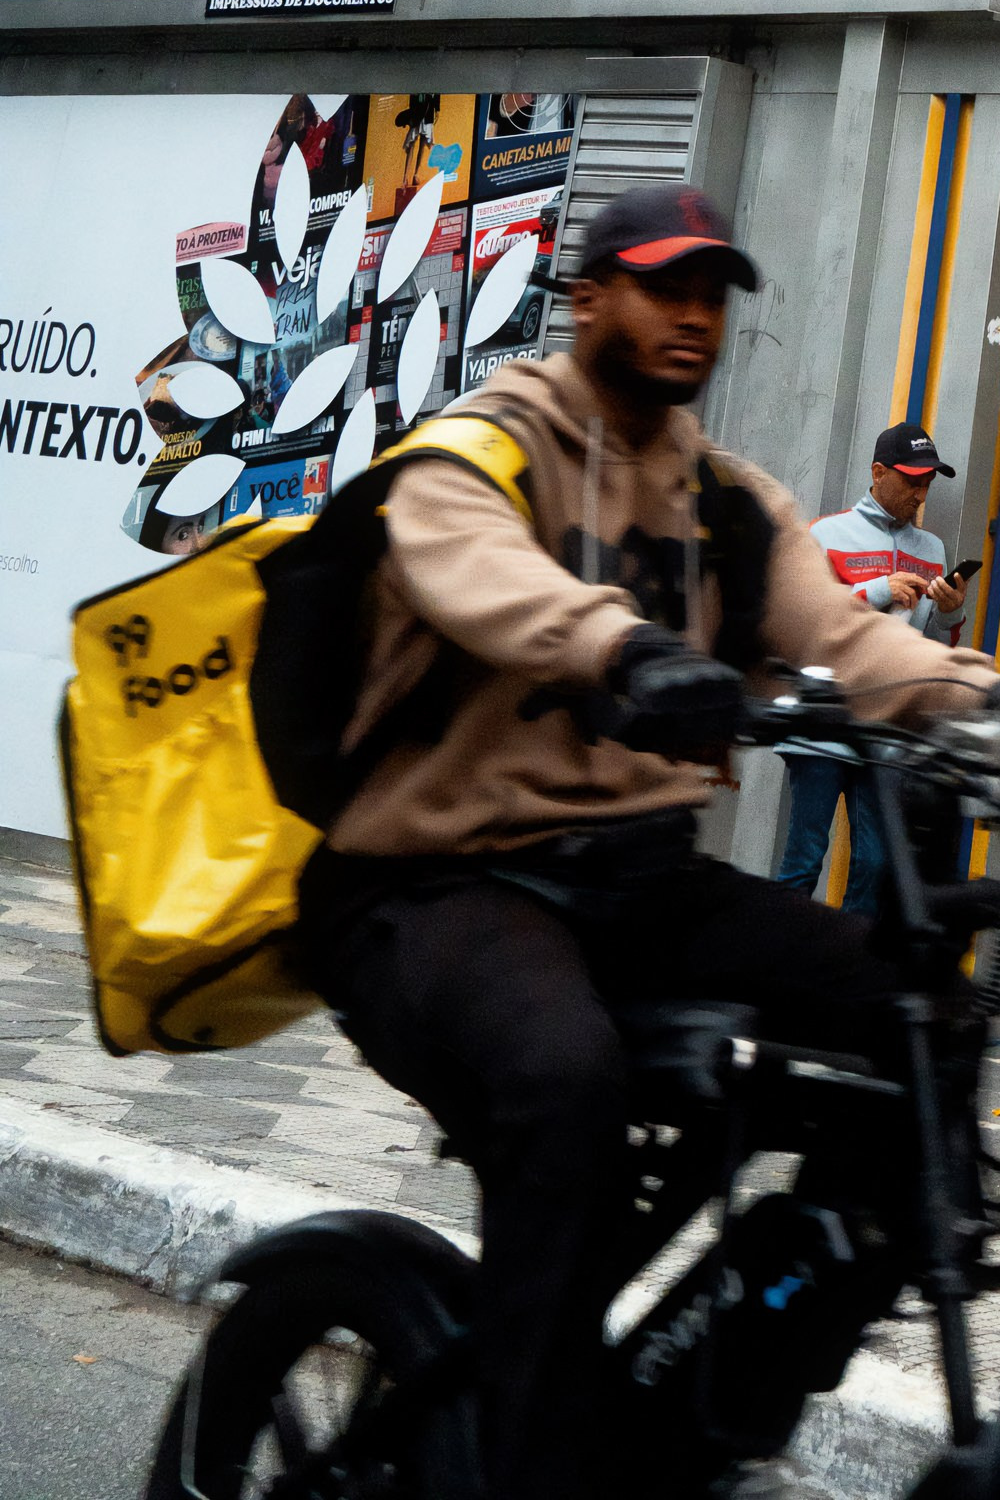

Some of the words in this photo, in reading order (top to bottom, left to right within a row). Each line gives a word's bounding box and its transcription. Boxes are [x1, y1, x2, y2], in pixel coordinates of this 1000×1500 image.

[481, 144, 535, 171] CANETAS
[535, 140, 553, 159] NA
[476, 203, 495, 217] TESTE
[494, 202, 502, 213] DO
[501, 200, 518, 212] NOVO
[518, 195, 541, 207] JETOUR
[541, 193, 548, 203] T2
[188, 234, 197, 249] À
[199, 225, 245, 248] PROTEÍNA
[0, 398, 146, 466] NTEXTO.
[231, 433, 242, 449] O
[242, 429, 264, 448] FIM
[250, 472, 300, 505] você
